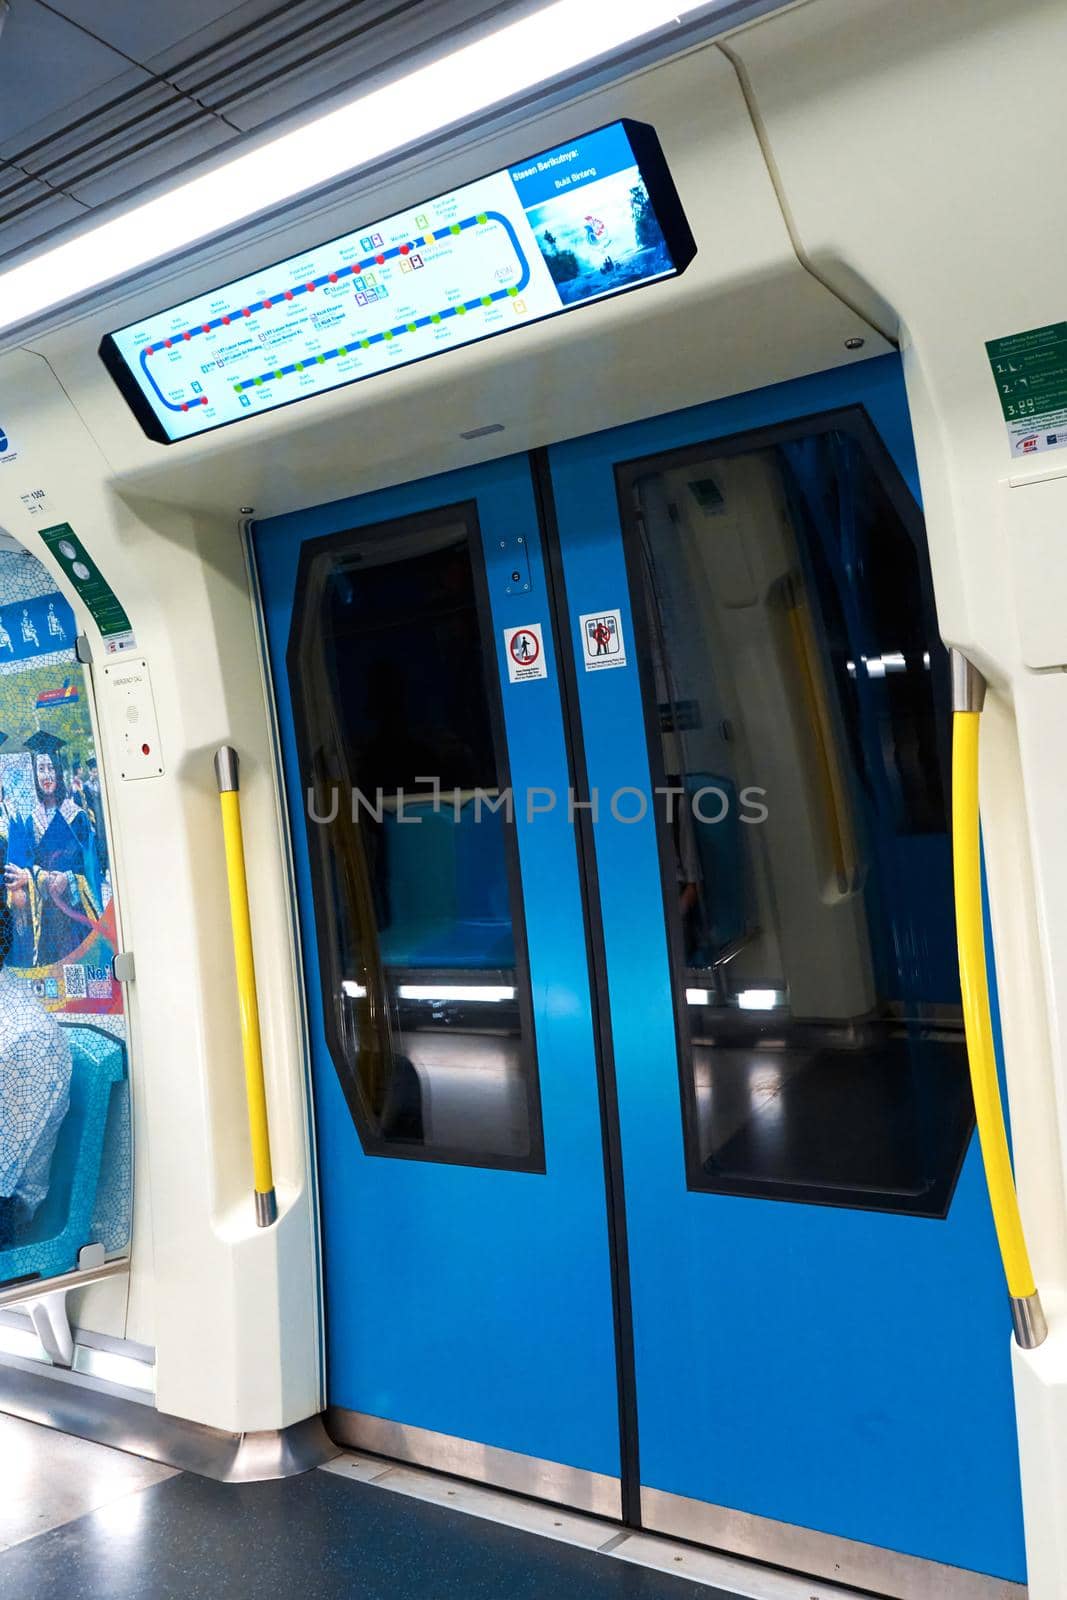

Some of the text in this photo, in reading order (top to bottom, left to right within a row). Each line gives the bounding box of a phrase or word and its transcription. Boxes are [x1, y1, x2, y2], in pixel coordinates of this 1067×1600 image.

[536, 149, 579, 171] Berikutnya:
[554, 167, 597, 189] Bukit Bintang
